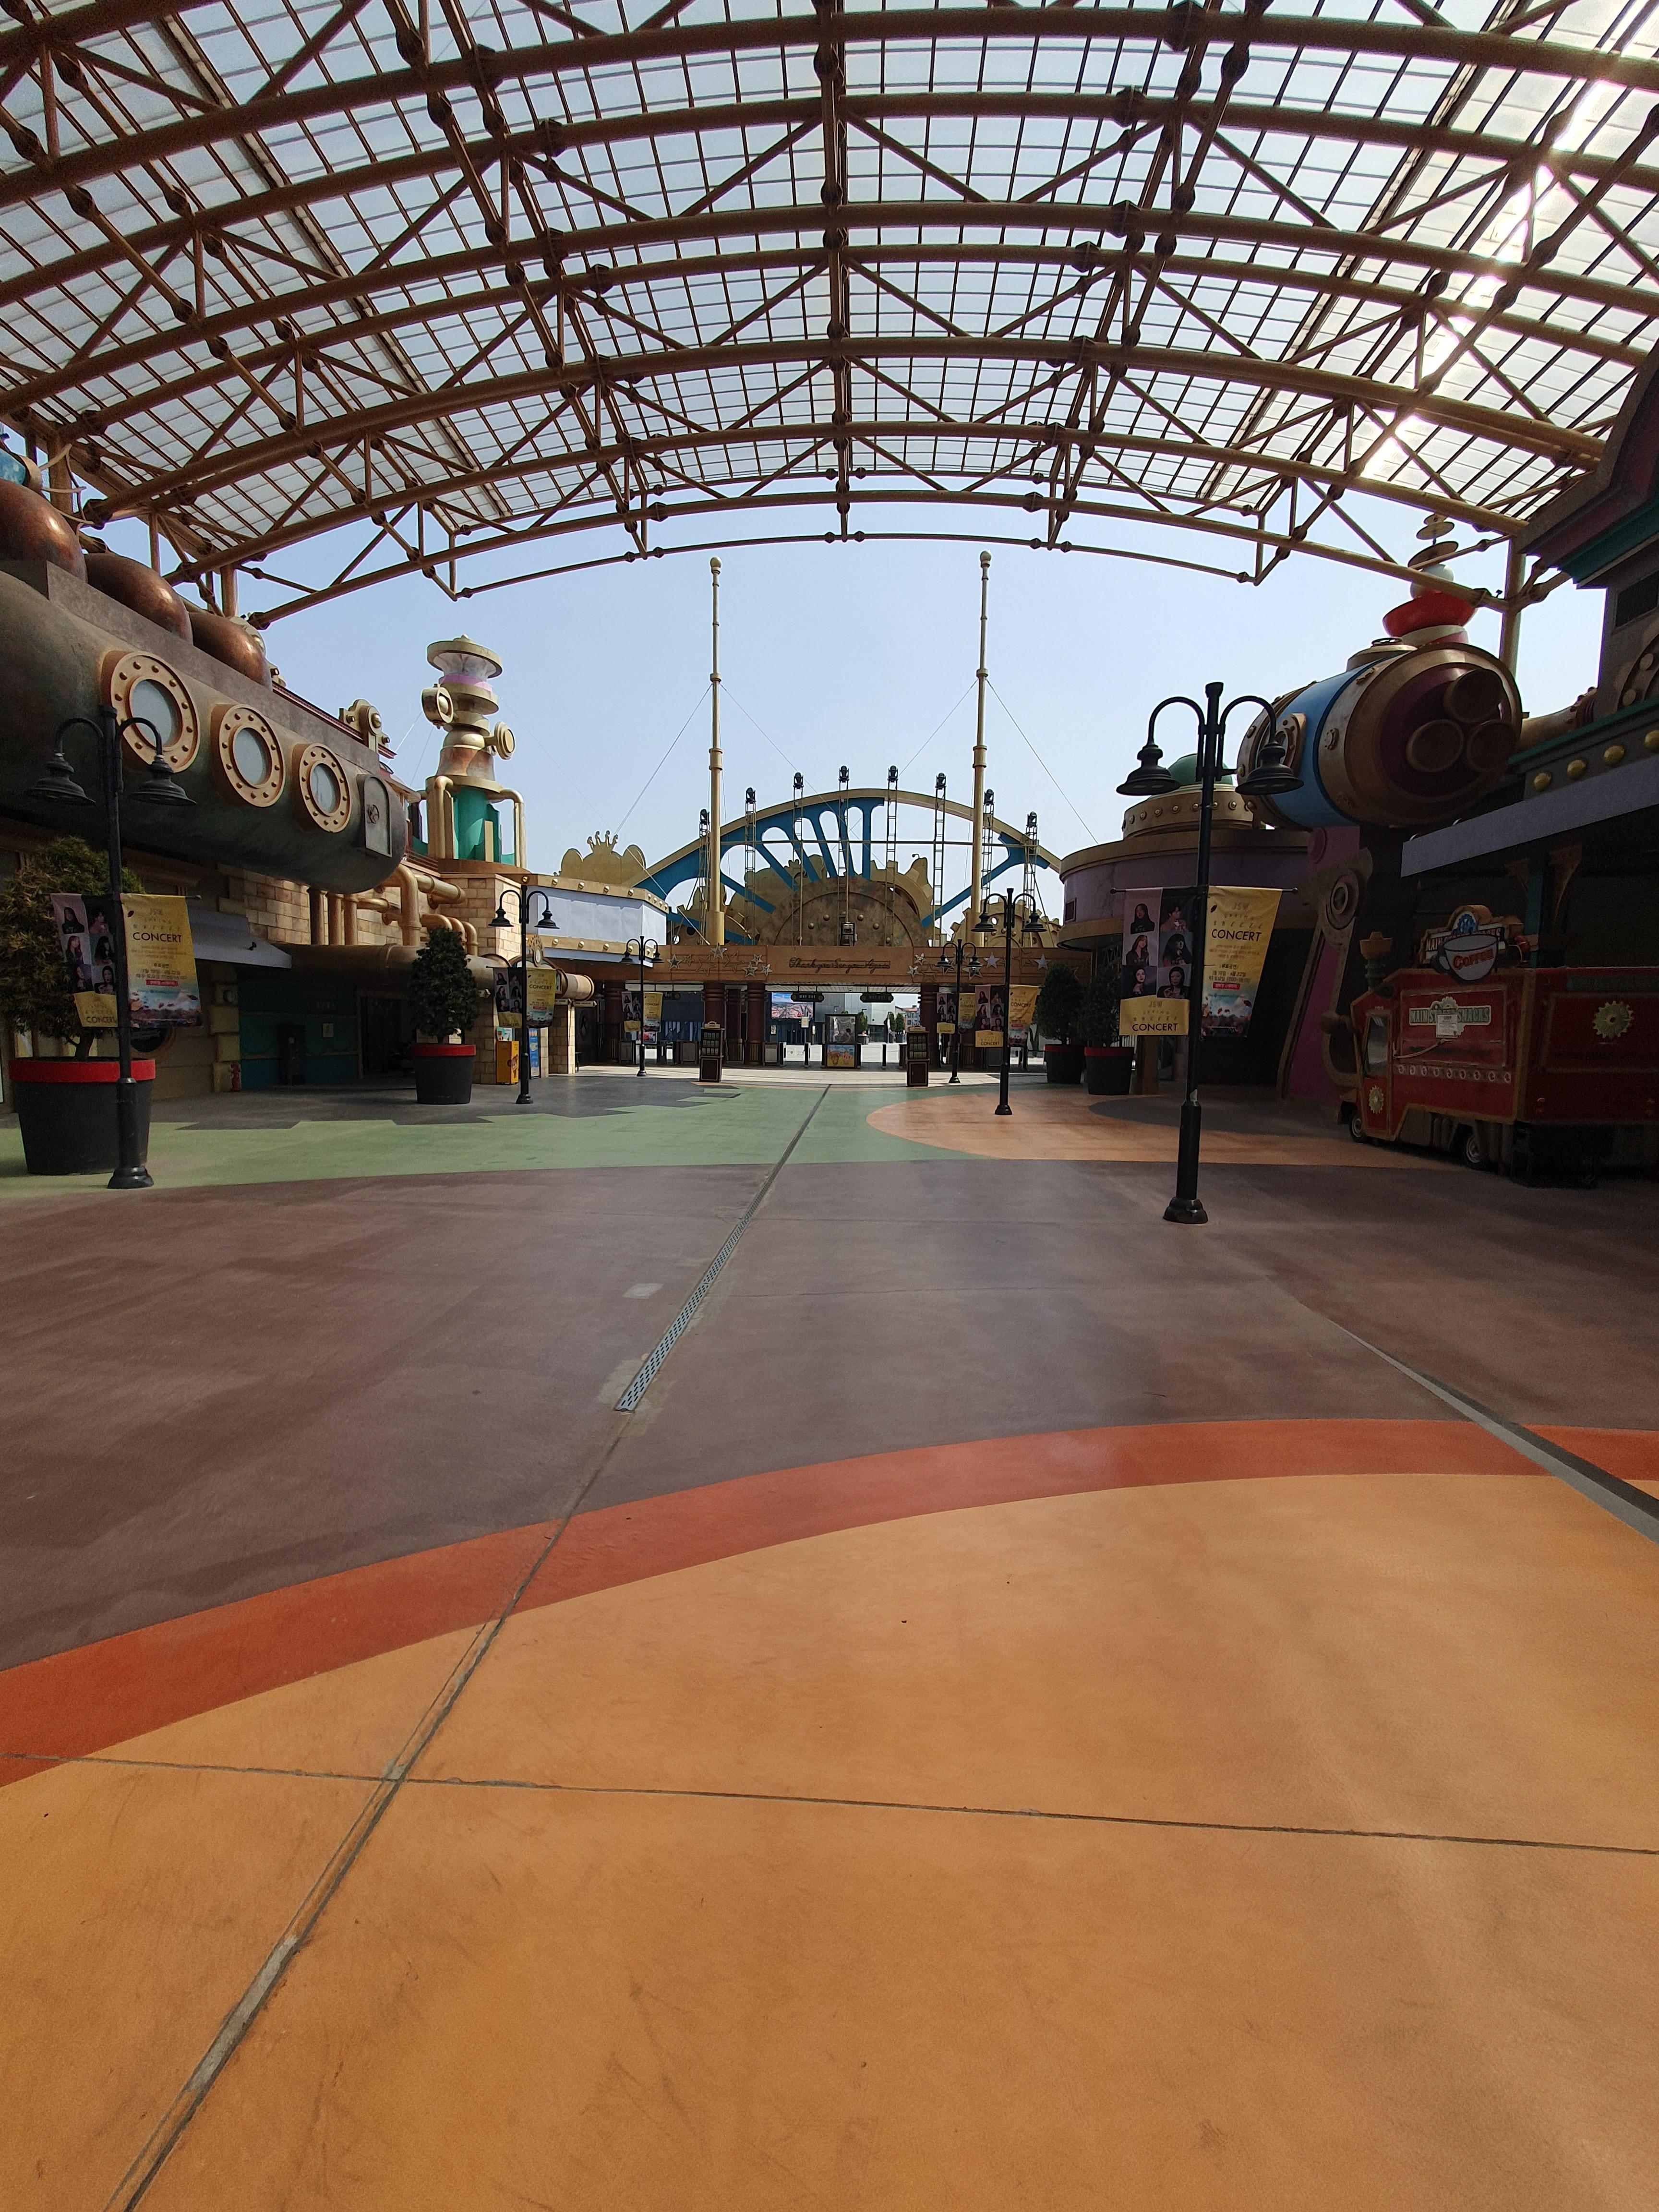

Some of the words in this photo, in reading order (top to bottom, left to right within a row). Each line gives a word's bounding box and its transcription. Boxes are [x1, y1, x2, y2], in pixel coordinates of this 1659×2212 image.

[133, 932, 182, 943] CONCERT
[1212, 929, 1262, 941] CONCERT
[1453, 949, 1494, 970] COFFEE
[1458, 1008, 1490, 1022] SNACKS
[1132, 1023, 1178, 1031] CONCERT
